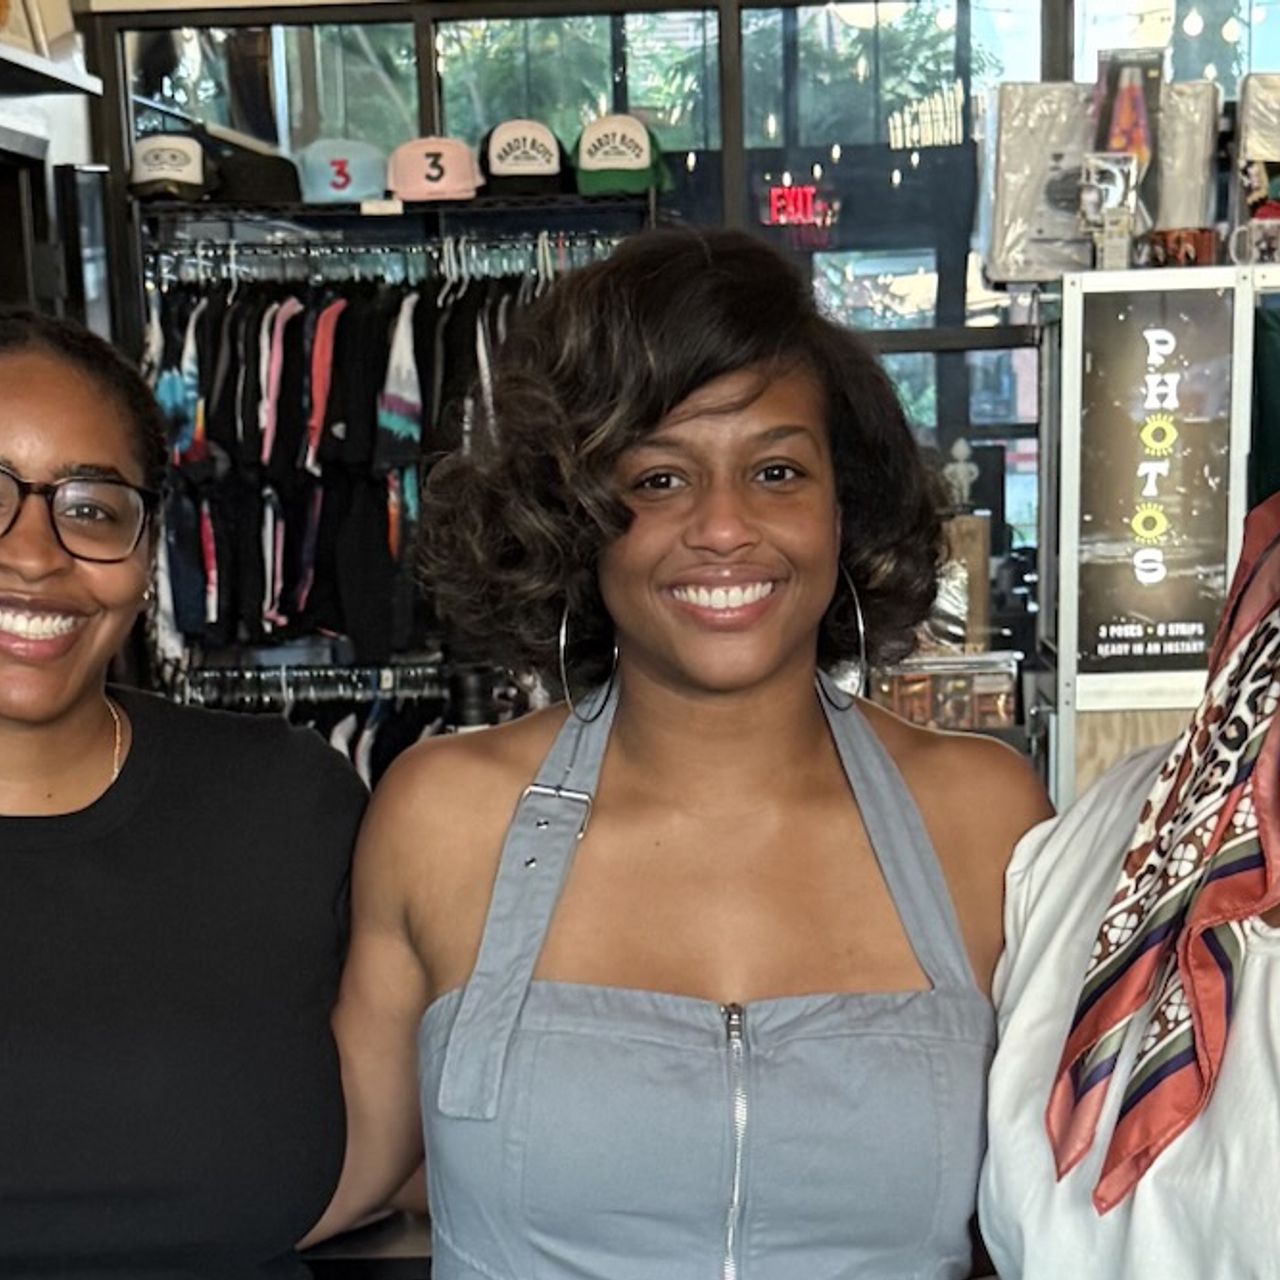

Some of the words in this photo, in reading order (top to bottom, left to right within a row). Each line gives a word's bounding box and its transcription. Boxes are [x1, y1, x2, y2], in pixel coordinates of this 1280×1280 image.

[329, 158, 352, 190] 3
[424, 151, 446, 182] 3
[770, 186, 816, 224] EXIT
[1131, 328, 1181, 585] PHOTOS
